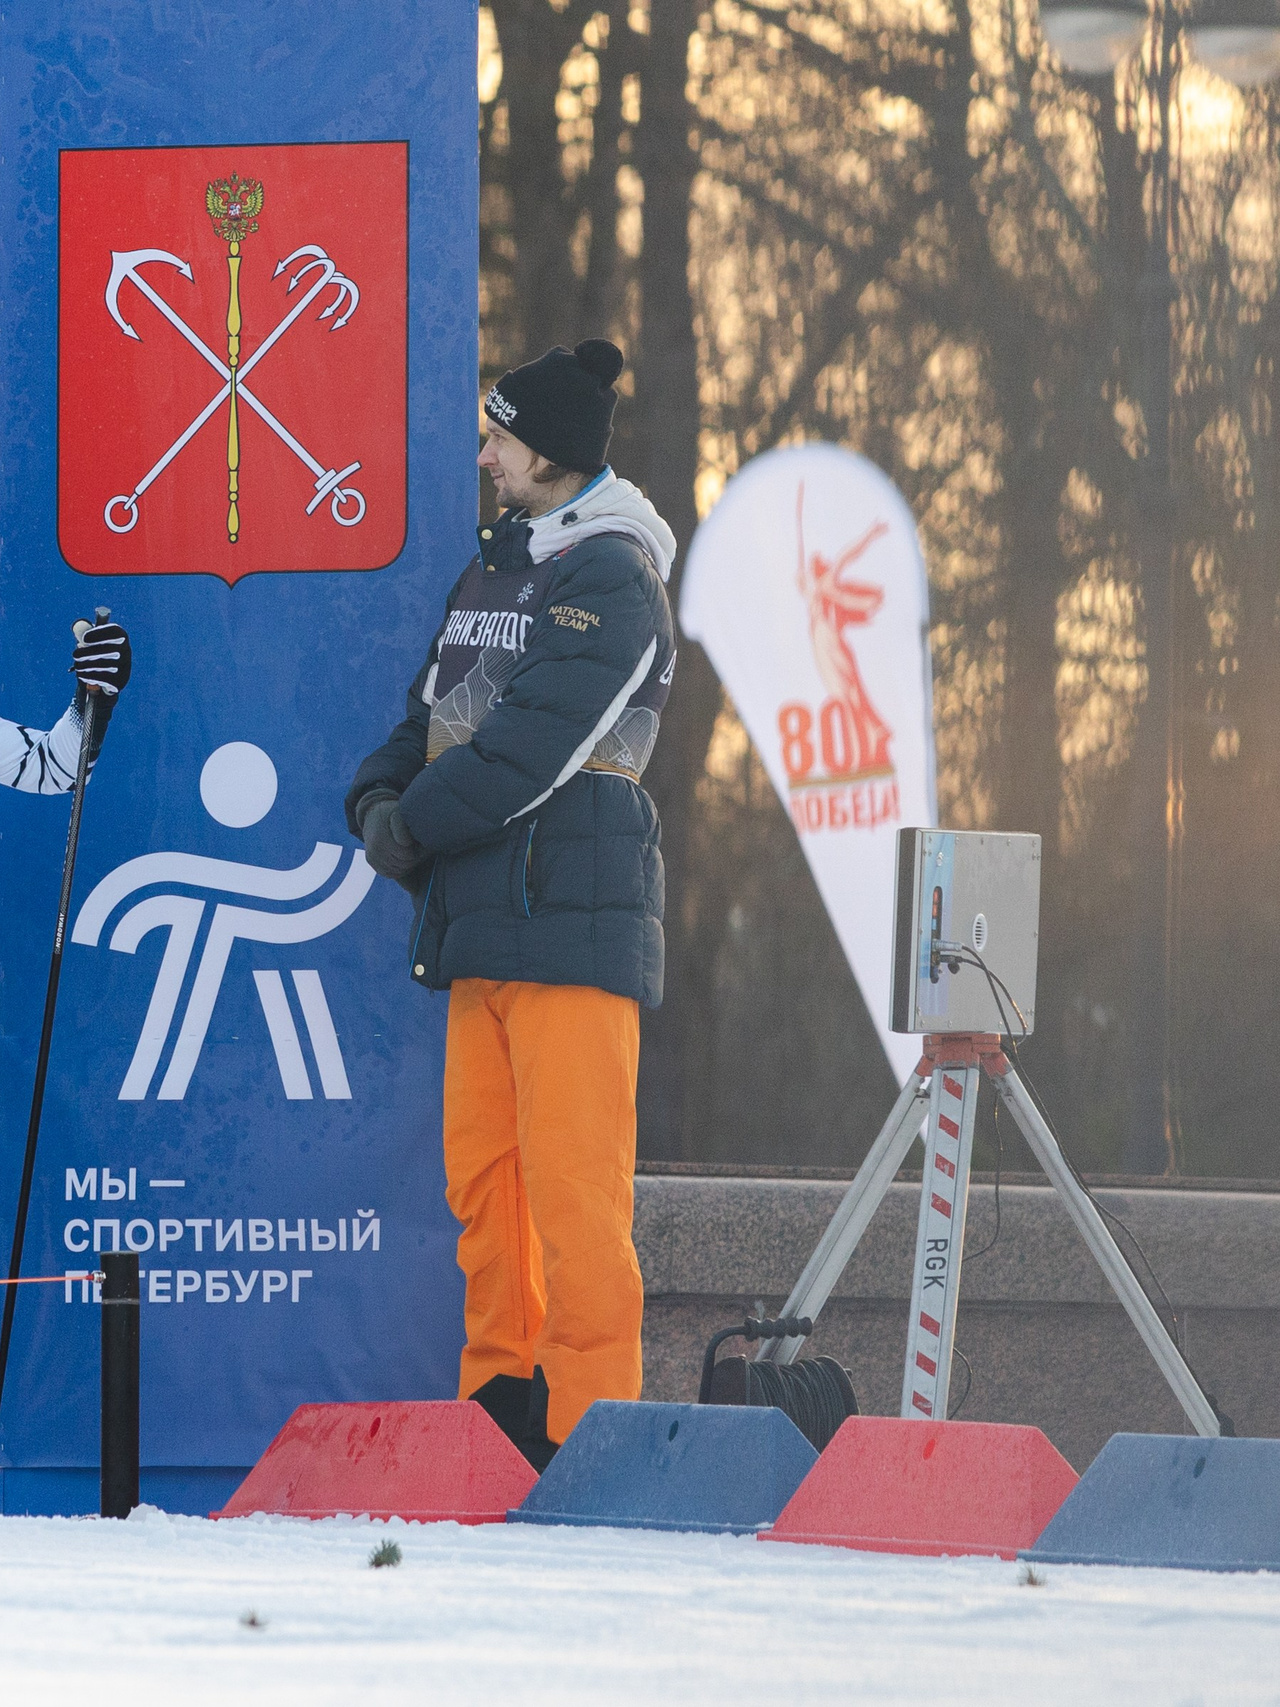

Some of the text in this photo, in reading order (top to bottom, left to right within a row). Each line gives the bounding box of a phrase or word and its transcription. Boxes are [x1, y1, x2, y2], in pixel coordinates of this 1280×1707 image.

[548, 605, 602, 628] NATIONAL
[554, 615, 589, 632] TEAM
[777, 699, 854, 781] 80
[55, 912, 65, 948] NORDWAY
[65, 1167, 137, 1201] МЫ
[63, 1208, 381, 1252] СПОРТИВНЫЙ
[923, 1238, 949, 1290] RGK
[64, 1269, 313, 1303] ПЕРБУРГ
